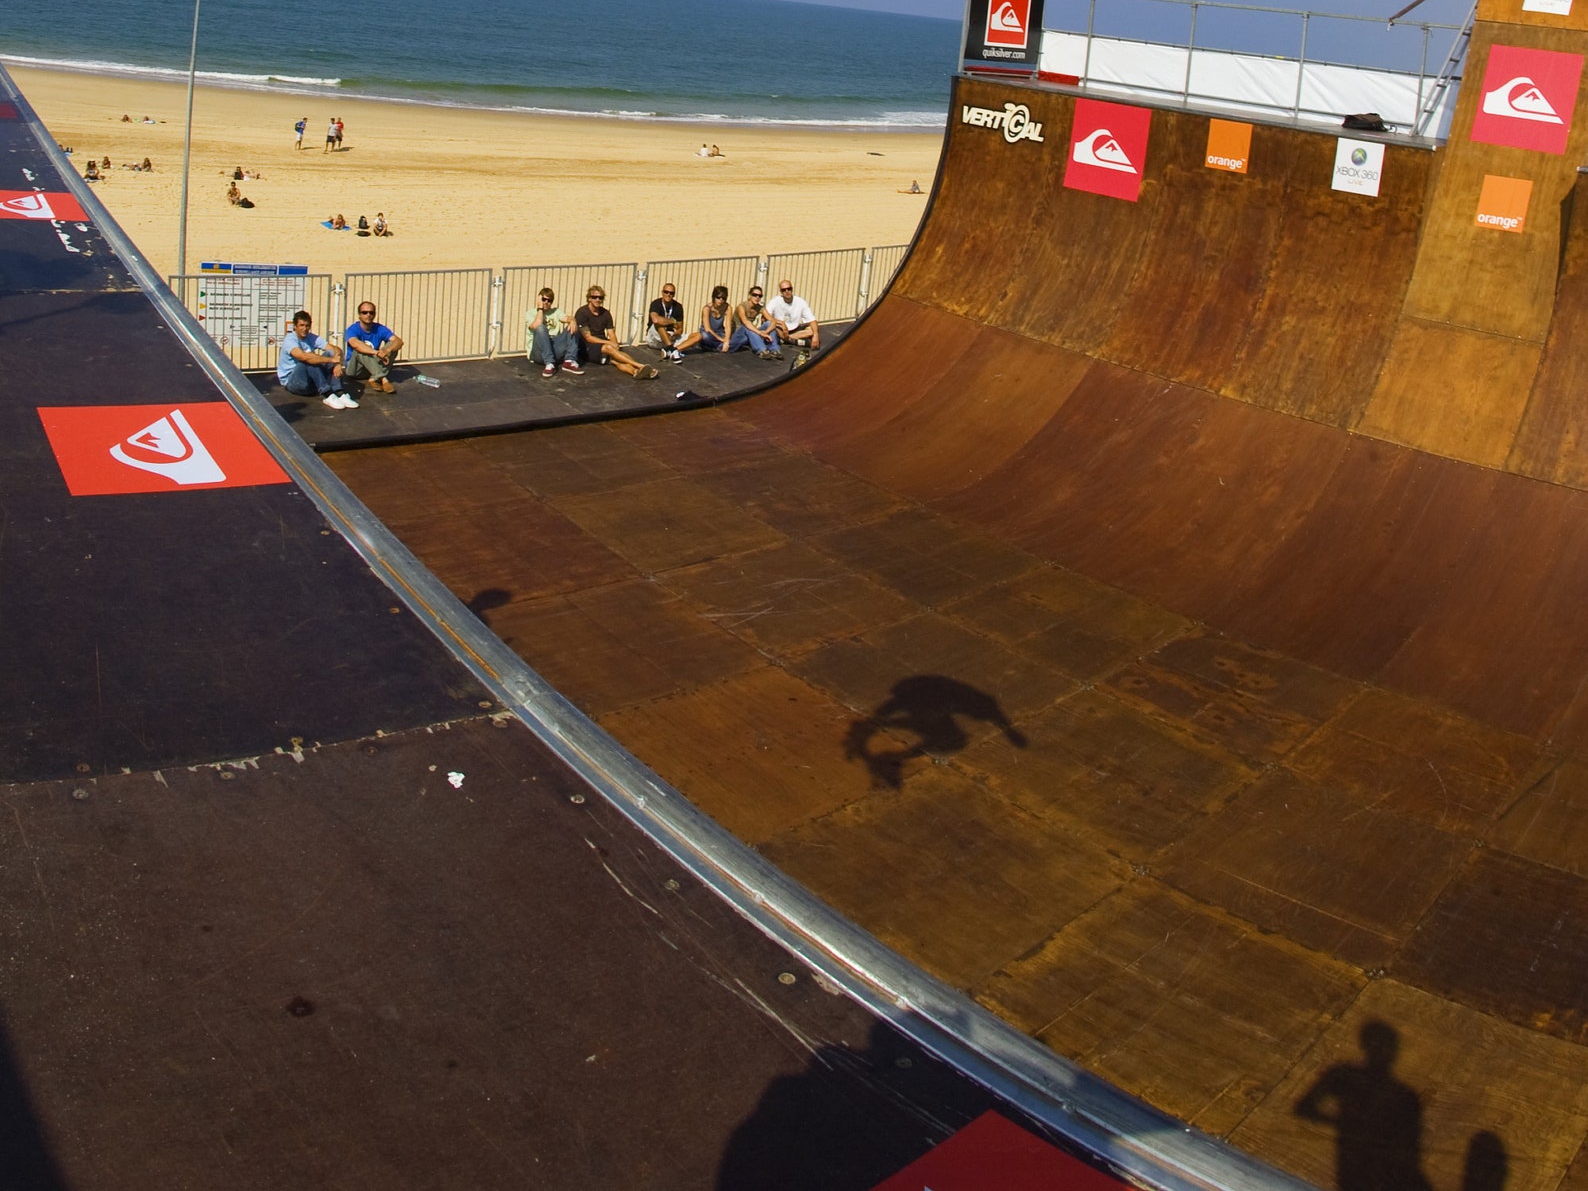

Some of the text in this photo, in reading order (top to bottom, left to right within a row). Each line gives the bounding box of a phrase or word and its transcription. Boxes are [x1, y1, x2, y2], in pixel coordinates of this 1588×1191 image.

[981, 47, 1026, 60] quiksilver.com
[1207, 155, 1244, 170] orange
[1336, 165, 1379, 181] XBOX 360
[1476, 213, 1519, 229] orange
